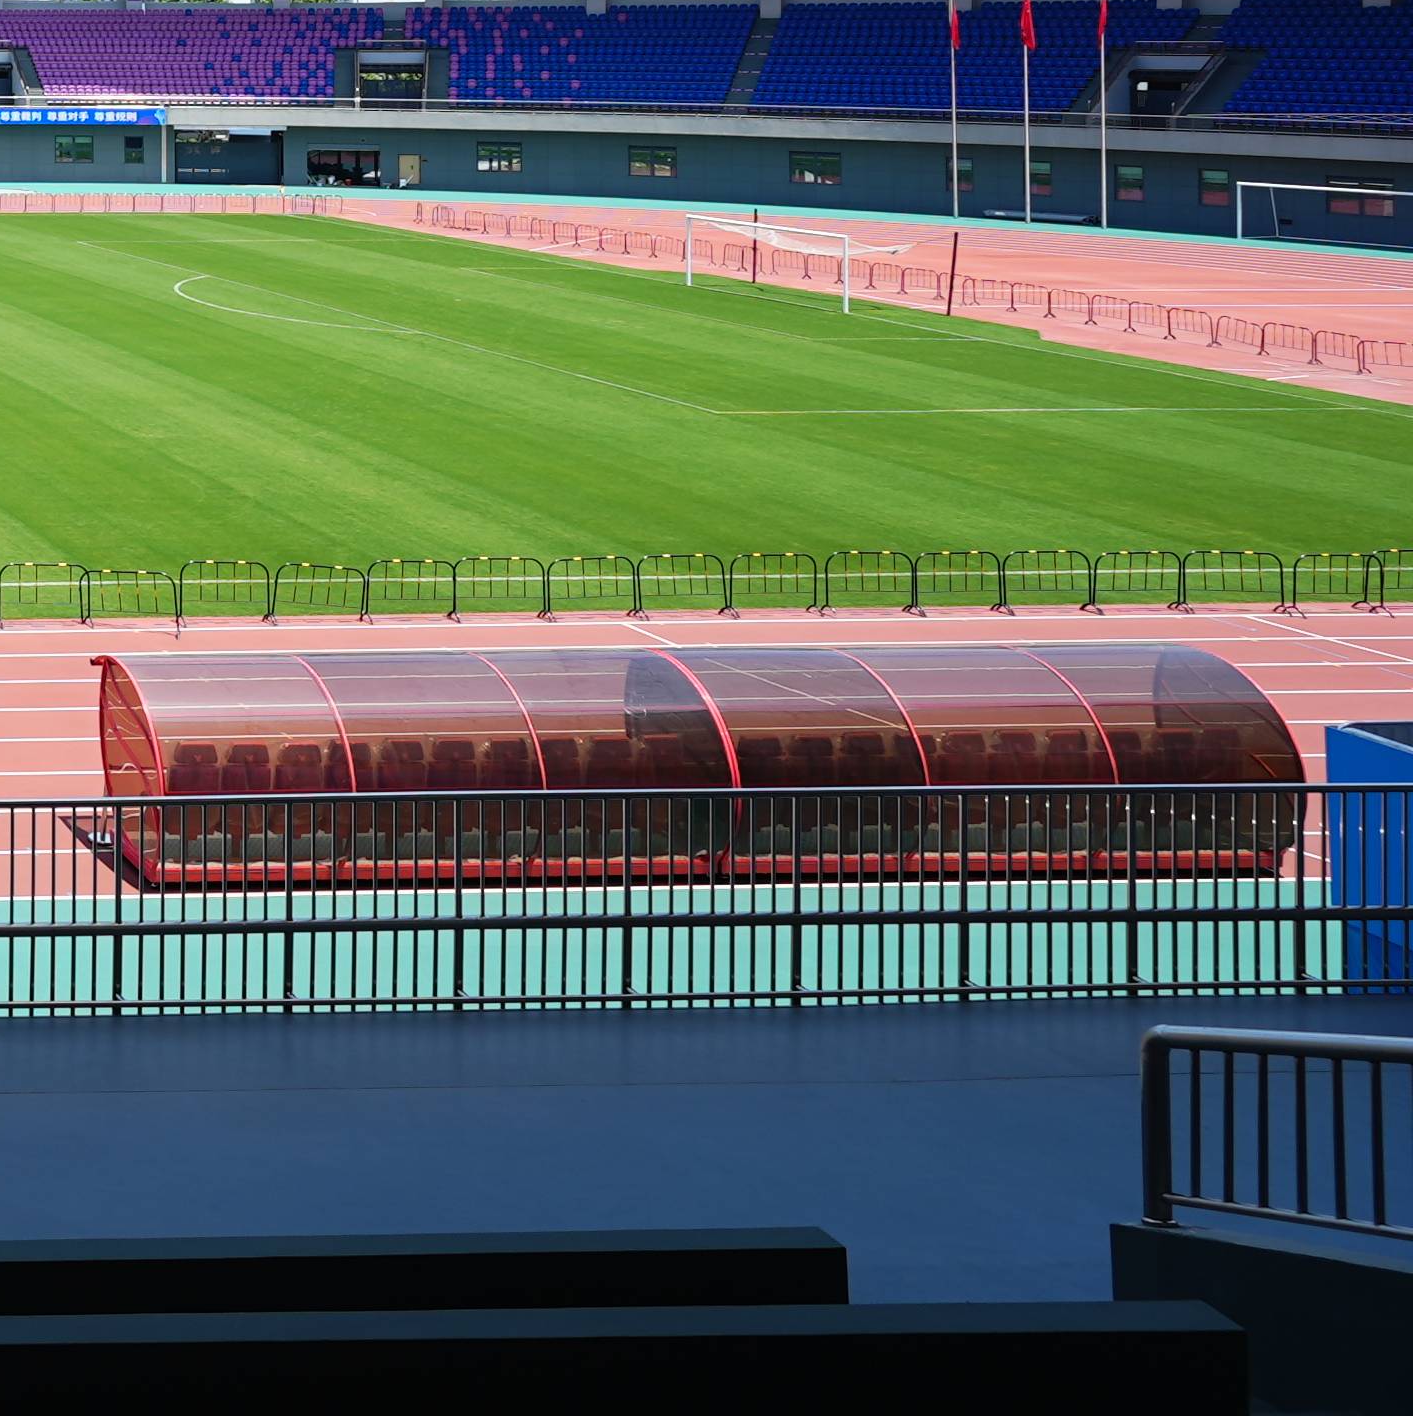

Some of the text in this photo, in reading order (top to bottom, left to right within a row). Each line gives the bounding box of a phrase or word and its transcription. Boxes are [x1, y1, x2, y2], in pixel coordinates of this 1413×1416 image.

[0, 111, 137, 122] 尊重裁判 尊重对手 尊重规则
